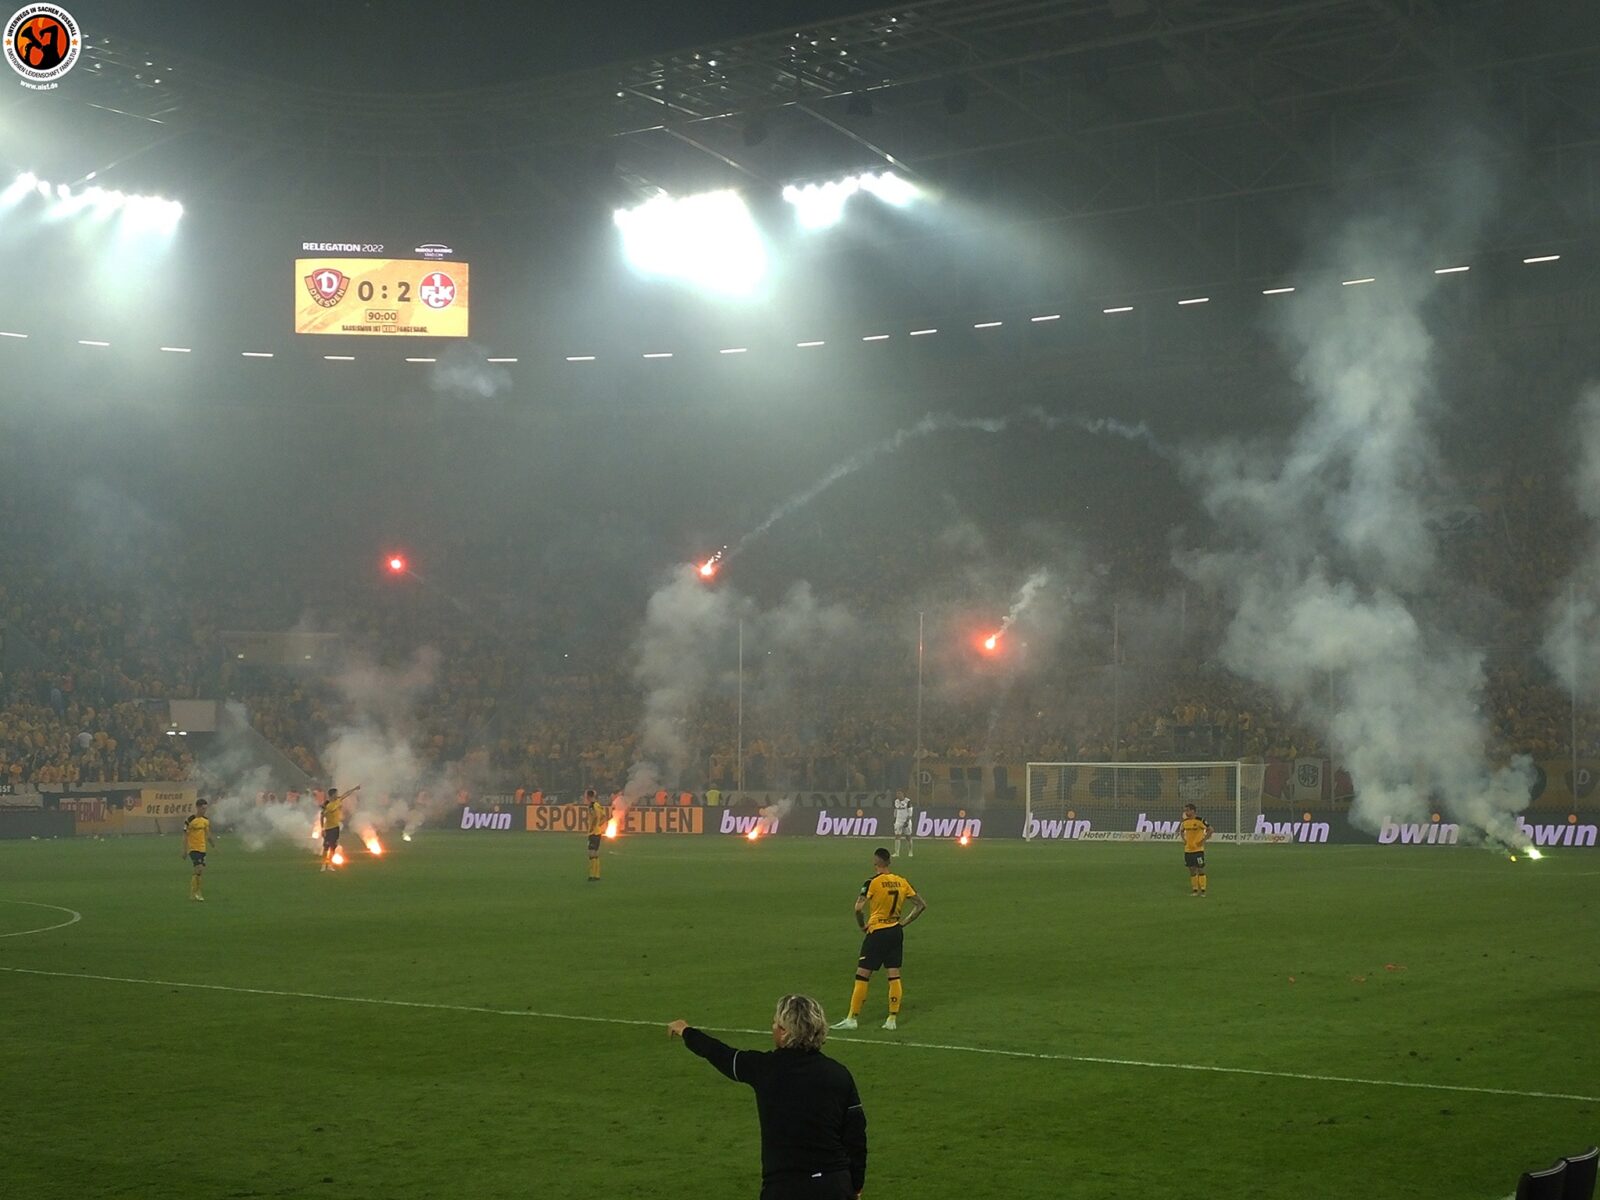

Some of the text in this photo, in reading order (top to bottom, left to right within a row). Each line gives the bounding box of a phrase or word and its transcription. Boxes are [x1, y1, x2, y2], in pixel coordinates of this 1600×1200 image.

[303, 243, 384, 253] RELEGATION 2022
[310, 288, 345, 307] DRESDEN
[358, 281, 374, 302] 0
[398, 282, 411, 302] 2
[368, 312, 397, 321] 90:00
[147, 804, 160, 814] DIE
[461, 806, 511, 830] bwin
[816, 809, 878, 836] bwin
[916, 810, 981, 837] bwin
[1022, 810, 1092, 840] bwin
[1254, 811, 1330, 842] bwin
[1378, 813, 1459, 844] bwin
[888, 890, 899, 917] 7
